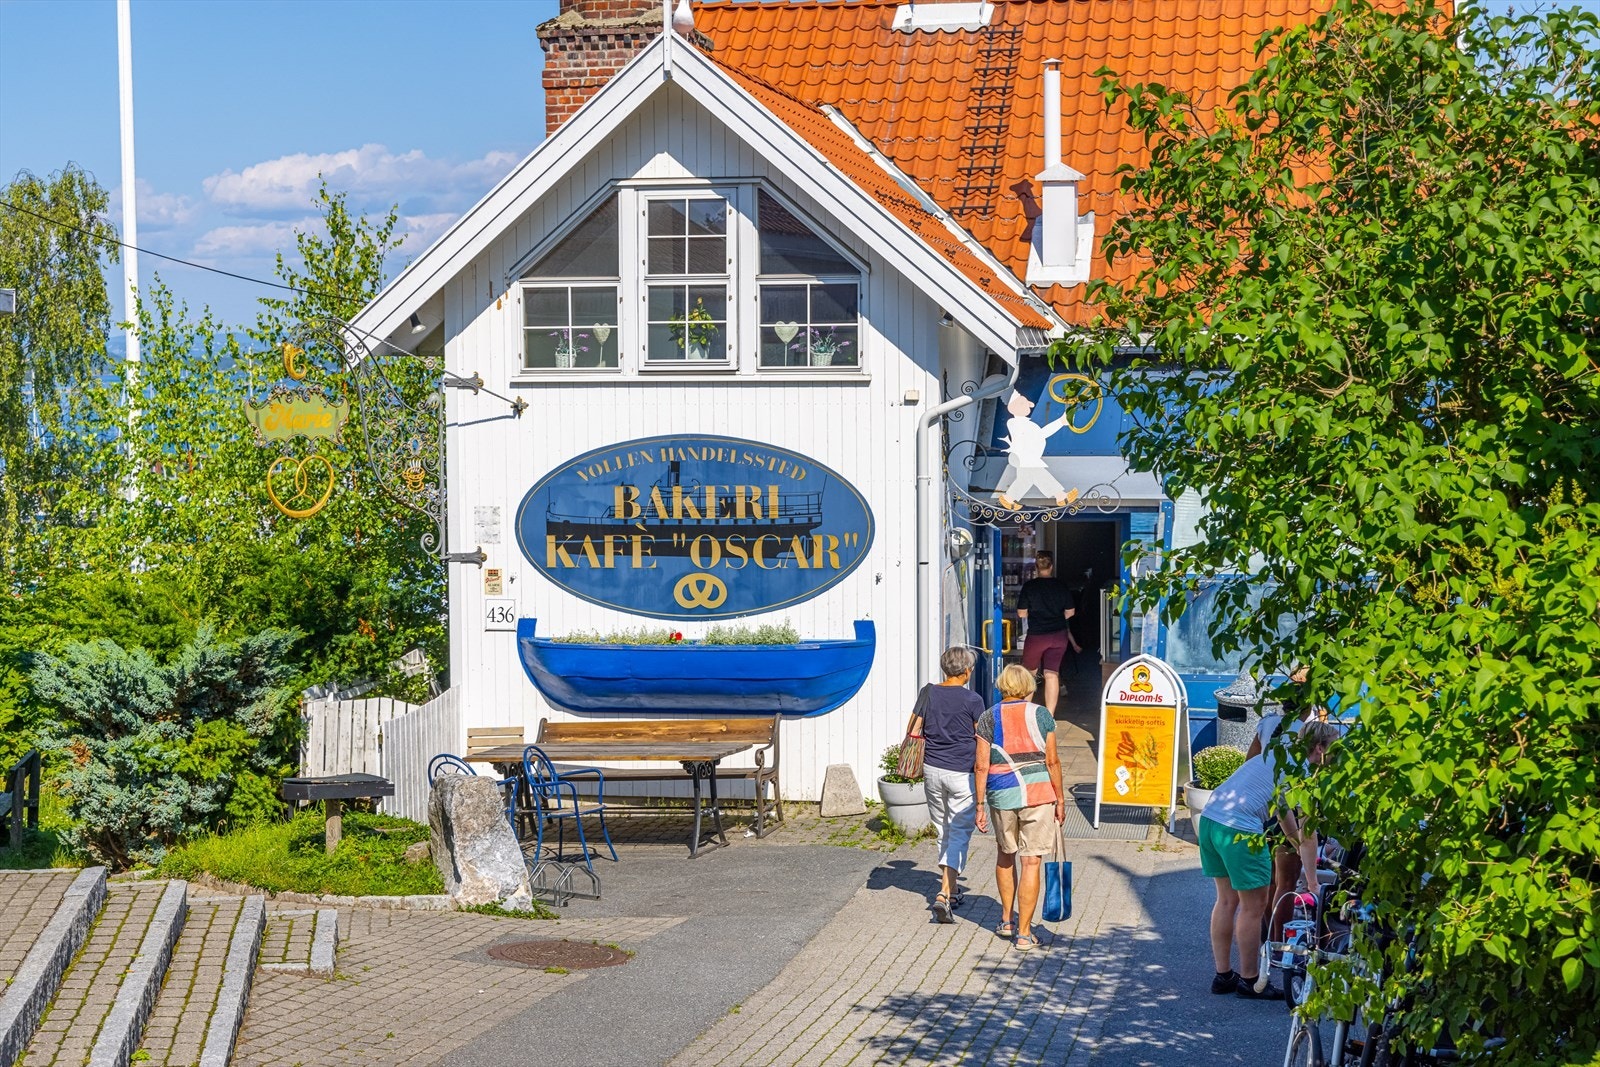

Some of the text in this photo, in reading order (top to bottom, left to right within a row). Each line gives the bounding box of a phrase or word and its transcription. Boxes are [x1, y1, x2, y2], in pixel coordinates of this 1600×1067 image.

[264, 403, 332, 431] Marie
[576, 446, 807, 482] VOLLEN HANDELSSTED
[613, 484, 782, 520] BAKERI
[672, 532, 858, 570] "OSCAR"
[486, 606, 514, 623] 436
